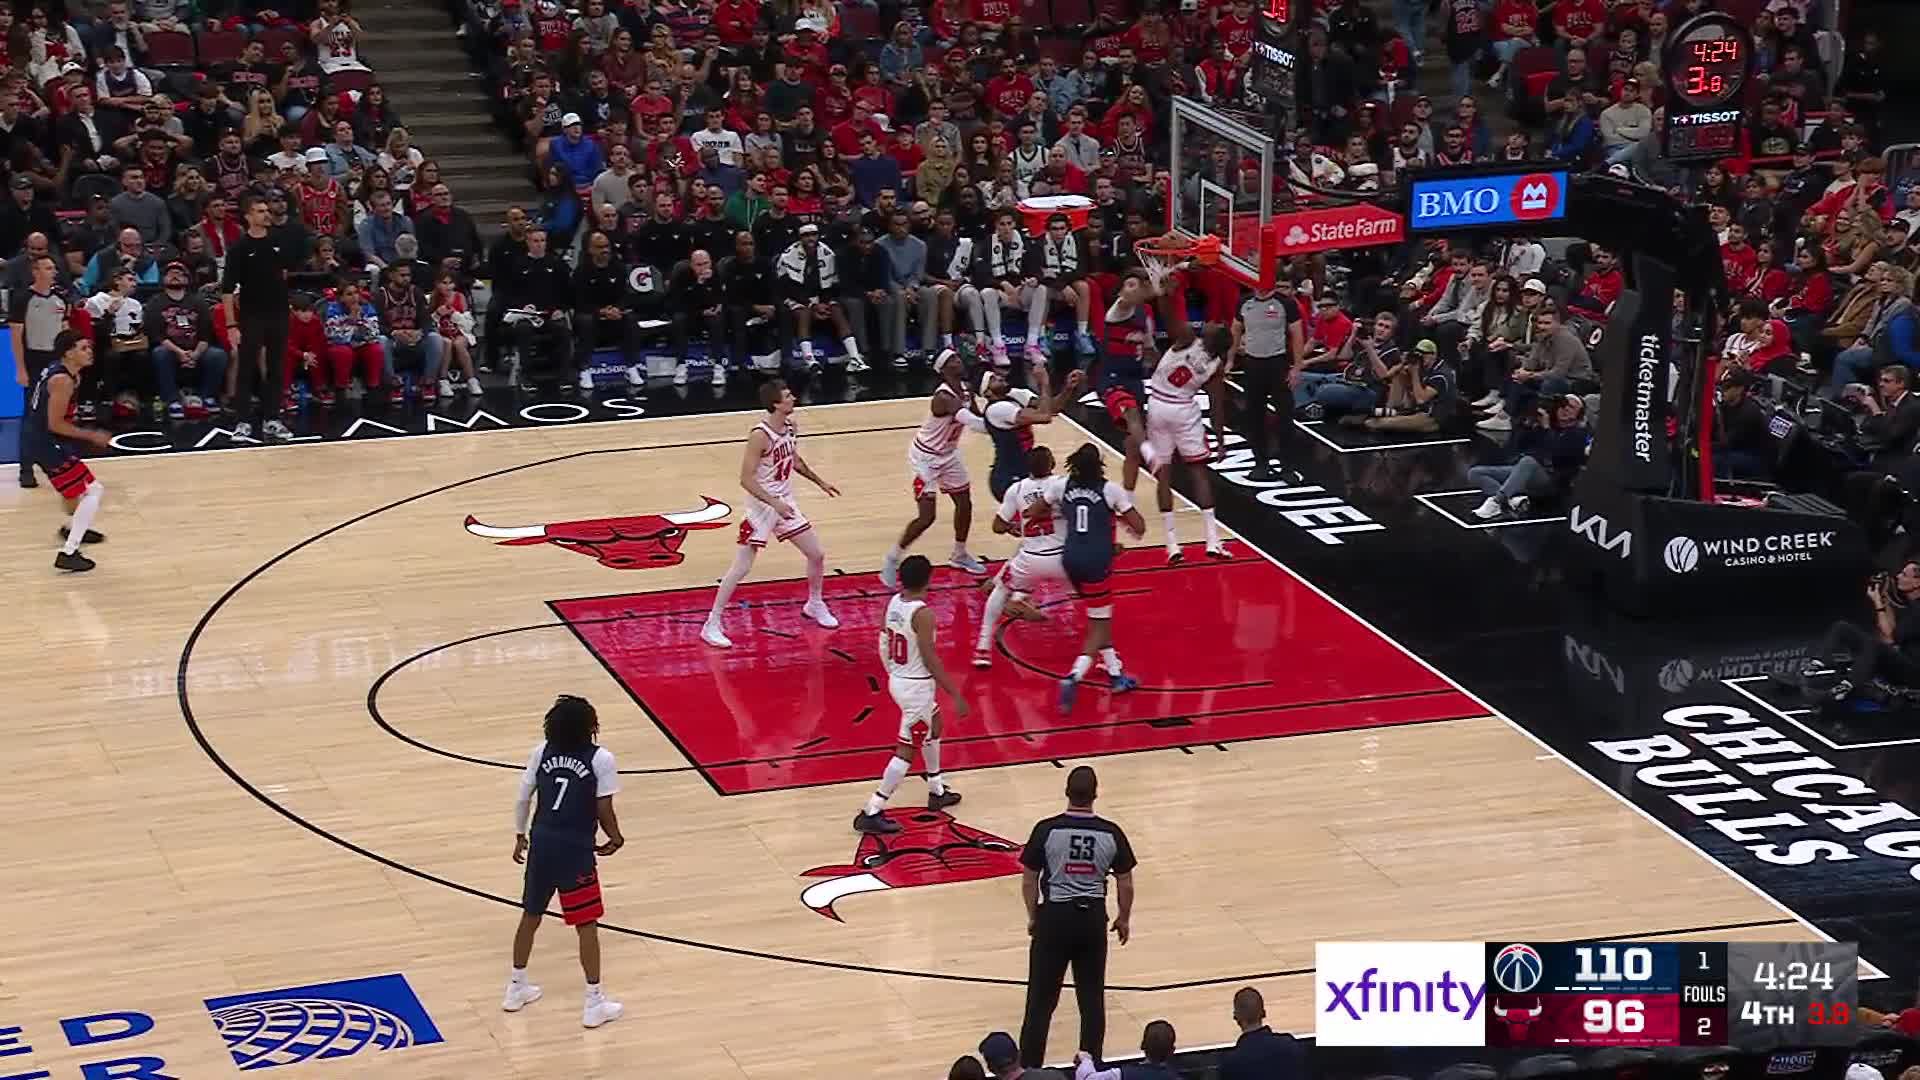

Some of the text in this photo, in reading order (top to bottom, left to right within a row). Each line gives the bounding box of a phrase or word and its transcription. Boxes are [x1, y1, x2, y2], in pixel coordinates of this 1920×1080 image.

[1694, 42, 1737, 62] 4:24
[1689, 110, 1740, 125] TISSOT
[1418, 188, 1500, 218] BMO
[1634, 332, 1661, 463] ticketmaster
[1076, 504, 1090, 533] 0
[1703, 531, 1834, 556] WIND CREEK
[1724, 555, 1767, 567] CASINO
[1777, 551, 1813, 563] HOTEL
[551, 776, 569, 811] 7
[1587, 733, 1860, 866] BULLS
[1662, 704, 1920, 882] CHICAG
[1069, 834, 1097, 861] 53
